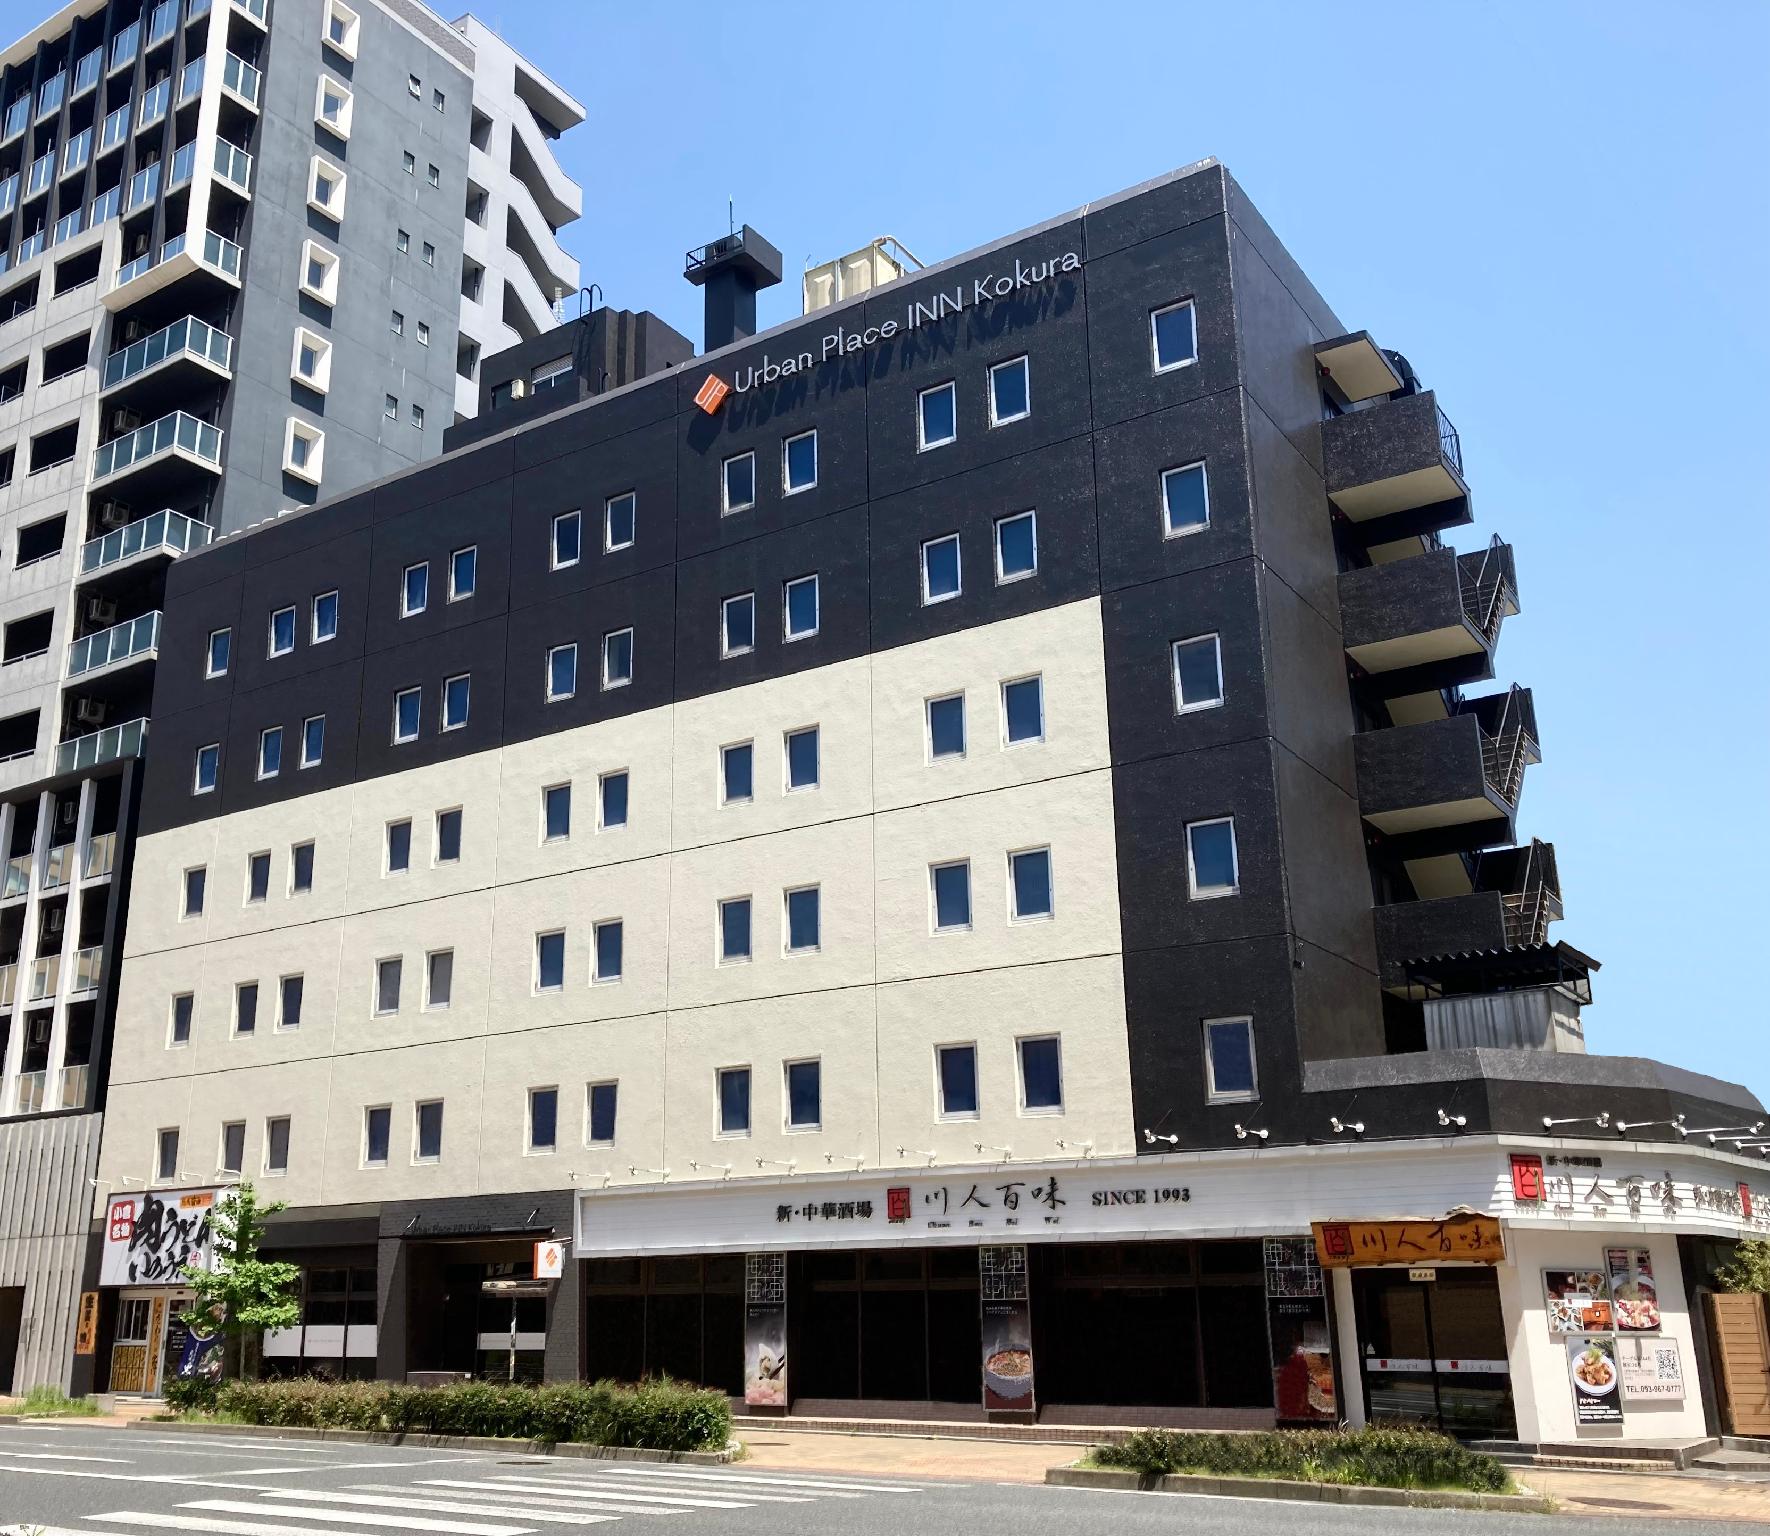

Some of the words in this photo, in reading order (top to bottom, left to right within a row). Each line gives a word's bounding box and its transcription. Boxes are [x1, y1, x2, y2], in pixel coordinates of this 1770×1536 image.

[734, 353, 814, 393] Urban
[822, 320, 898, 362] Place
[908, 286, 963, 329] INN
[974, 252, 1081, 305] Kokura
[925, 1176, 1066, 1215] 川人百味
[1092, 1190, 1146, 1207] SINCE
[1154, 1188, 1191, 1204] 1993
